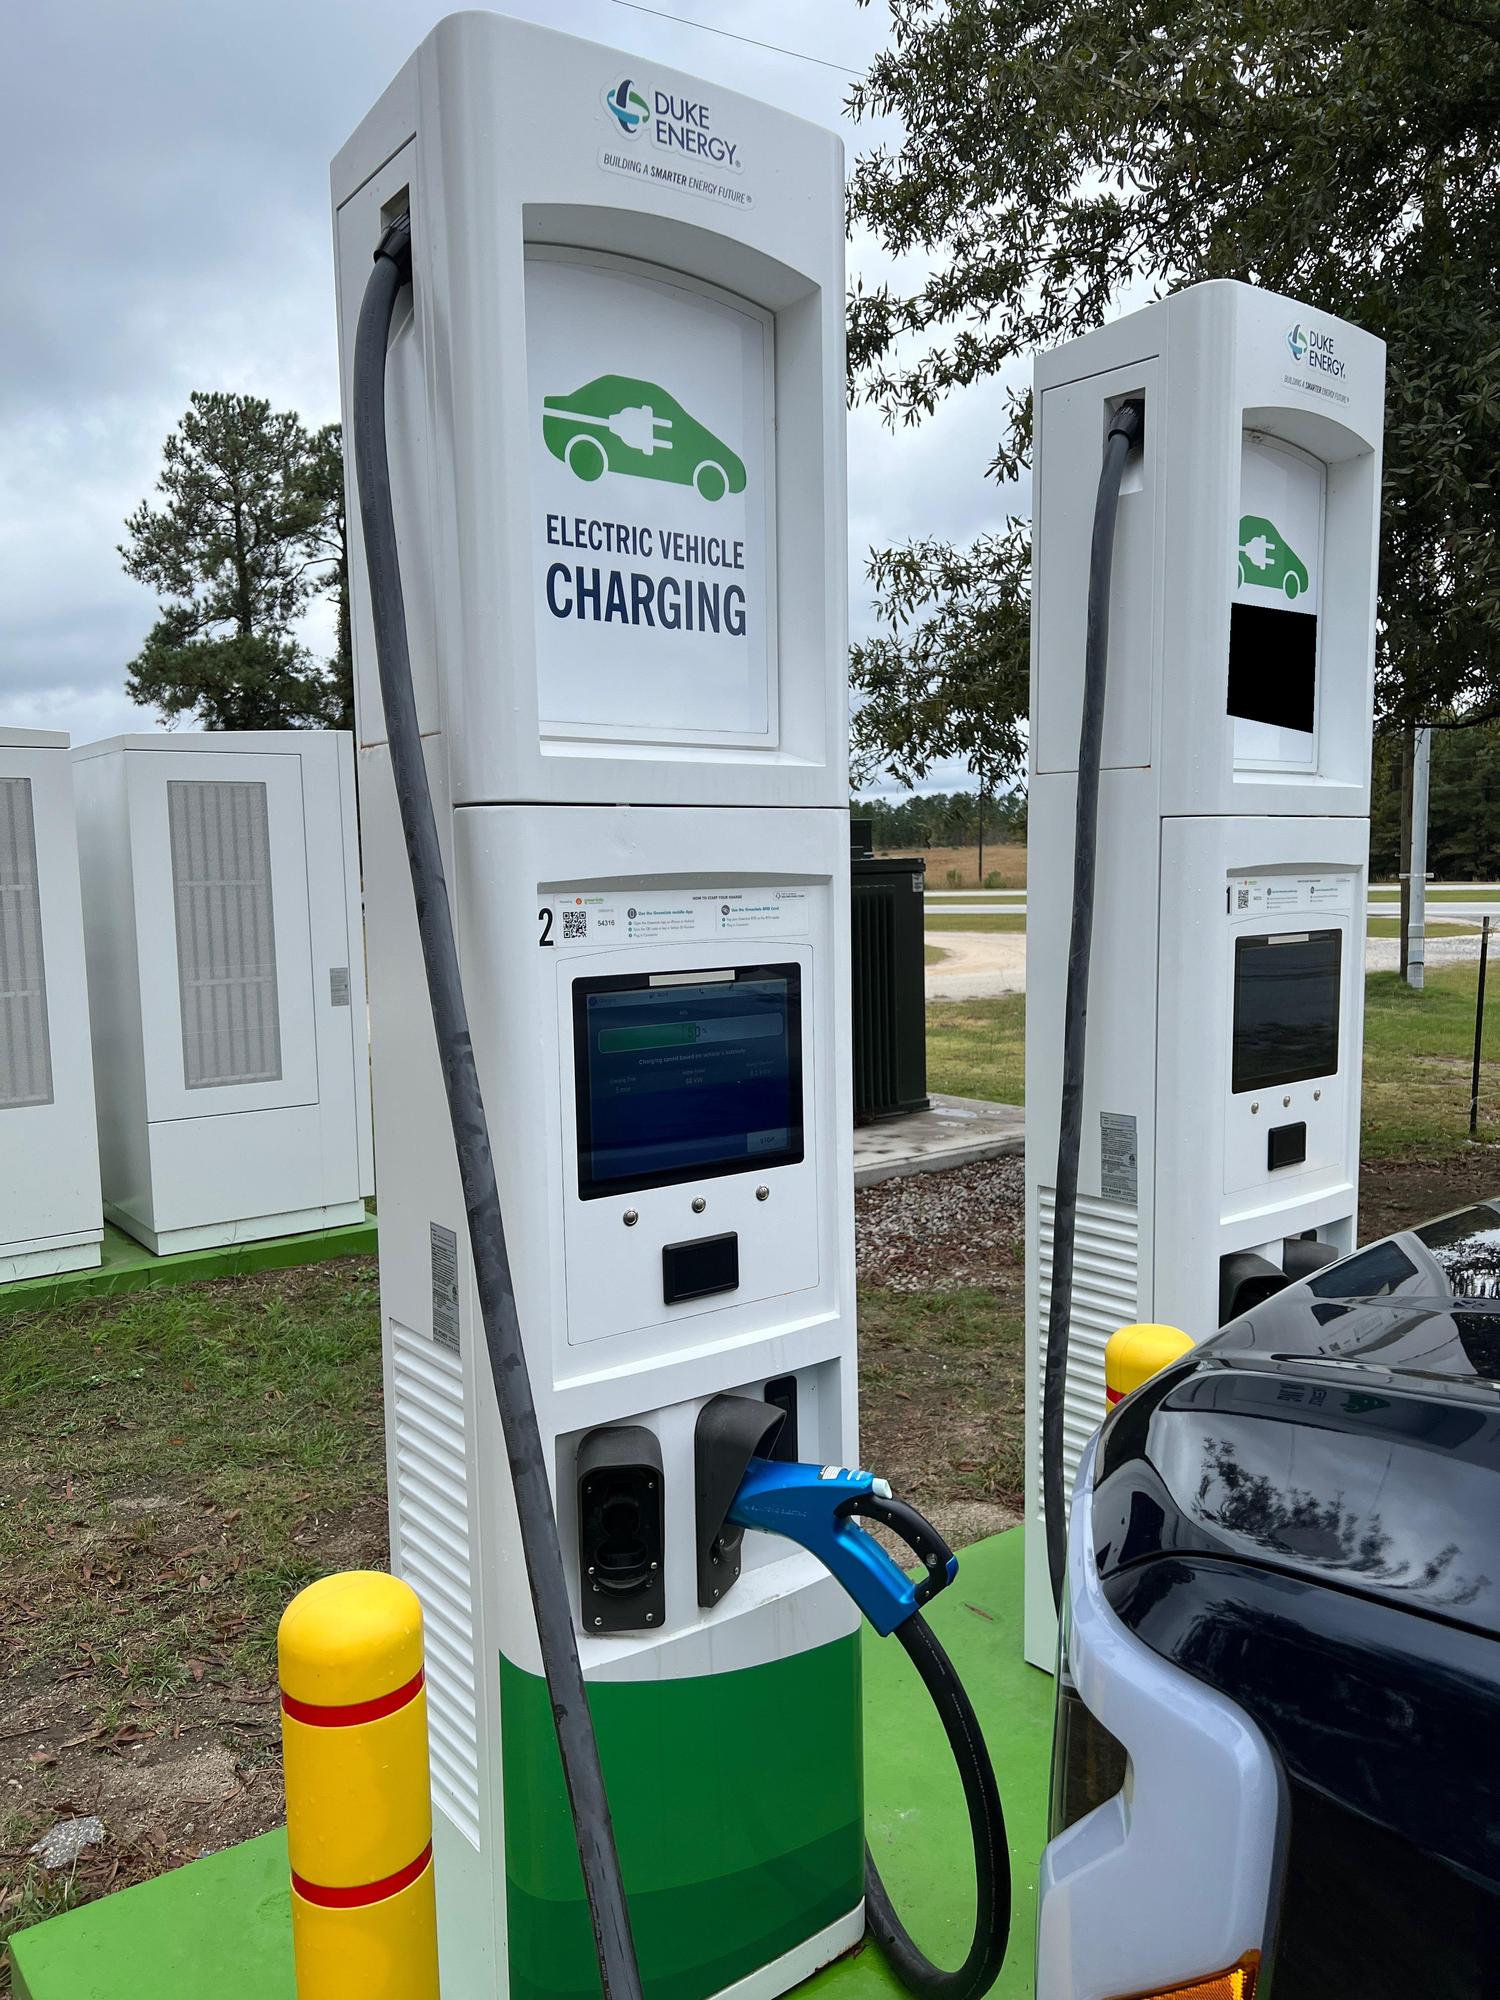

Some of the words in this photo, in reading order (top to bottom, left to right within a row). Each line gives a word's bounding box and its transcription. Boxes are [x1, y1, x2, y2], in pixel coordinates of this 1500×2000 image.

[655, 90, 710, 130] DUKE
[656, 119, 737, 165] ENERGY
[603, 153, 642, 174] BUILDING
[643, 163, 649, 176] A
[650, 165, 687, 186] SMARTER
[688, 177, 718, 195] ENERGY
[718, 185, 746, 204] FUTURE
[1309, 330, 1335, 355] DUKE
[1309, 350, 1345, 378] ENERGY
[546, 513, 653, 558] ELECTRIC
[658, 529, 745, 570] VEHICLE
[546, 562, 747, 637] CHARGING
[538, 907, 555, 947] 2
